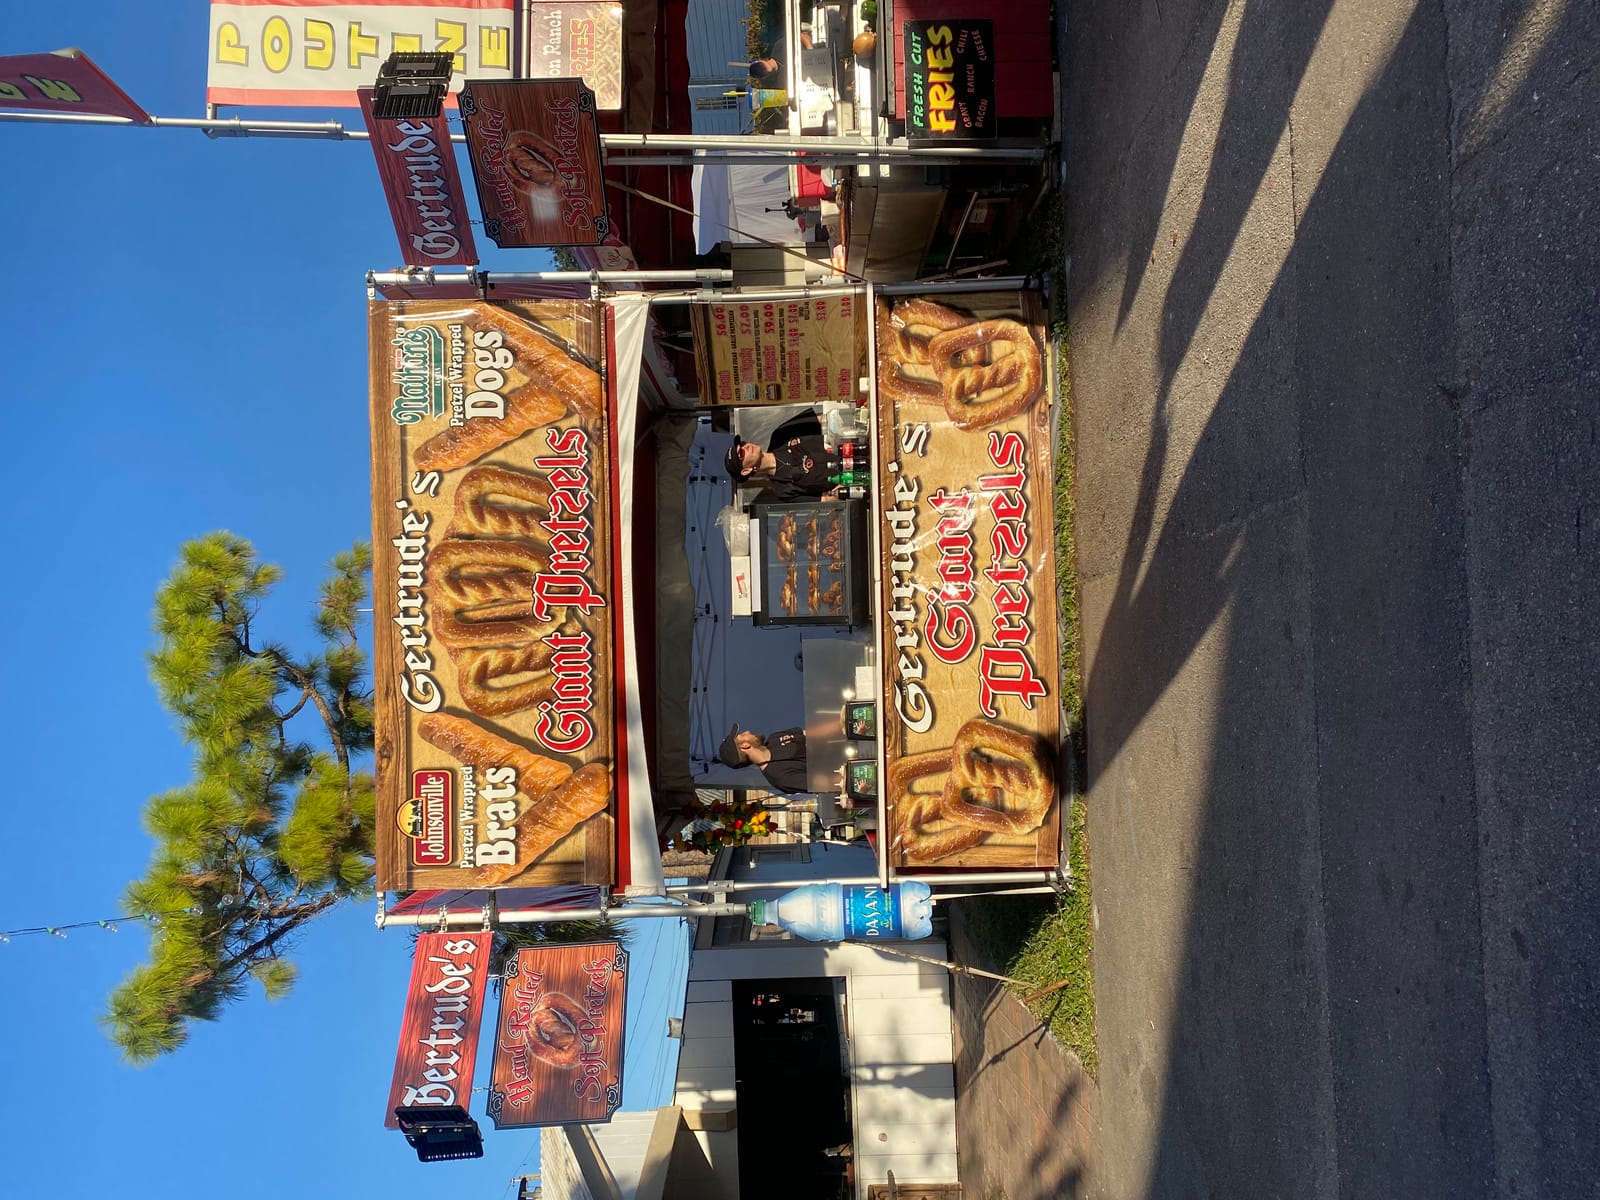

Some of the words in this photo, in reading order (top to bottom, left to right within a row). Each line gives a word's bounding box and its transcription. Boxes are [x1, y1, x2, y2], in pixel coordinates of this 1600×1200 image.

[215, 15, 510, 74] POUTINE
[542, 10, 562, 56] Ranch
[569, 18, 595, 78] RIES
[911, 31, 922, 65] CUT
[956, 29, 969, 54] CHILI
[971, 29, 988, 61] CHEESE
[549, 59, 561, 76] on
[926, 24, 956, 134] FRIES
[966, 63, 975, 93] RANCH
[912, 72, 924, 127] FRESH
[958, 101, 973, 128] GRAVY
[974, 98, 989, 128] BACON
[479, 99, 510, 174] Rolled
[545, 97, 586, 180] Pretzels
[387, 117, 461, 259] Gertrude
[479, 174, 527, 233] Hand
[561, 180, 592, 231] Soft
[390, 329, 430, 425] Nathan's
[448, 324, 465, 380] Wrapped
[464, 330, 514, 420] Dogs
[449, 383, 464, 427] Pretzel
[533, 428, 606, 621] Pretzels
[391, 471, 442, 713] Gertrude's
[885, 423, 934, 734] Gertrude's
[924, 489, 976, 664] Giant
[978, 431, 1047, 718] Pretzels
[535, 632, 593, 752] Giant
[420, 775, 445, 860] Johnsonville
[460, 766, 476, 822] Wrapped
[475, 767, 516, 867] Brats
[460, 825, 474, 868] Pretzel
[861, 886, 881, 936] DASANI
[507, 963, 544, 1038] Rolled
[576, 957, 612, 1042] Pretzels
[500, 1040, 535, 1108] Hand
[574, 1044, 608, 1102] Soft
